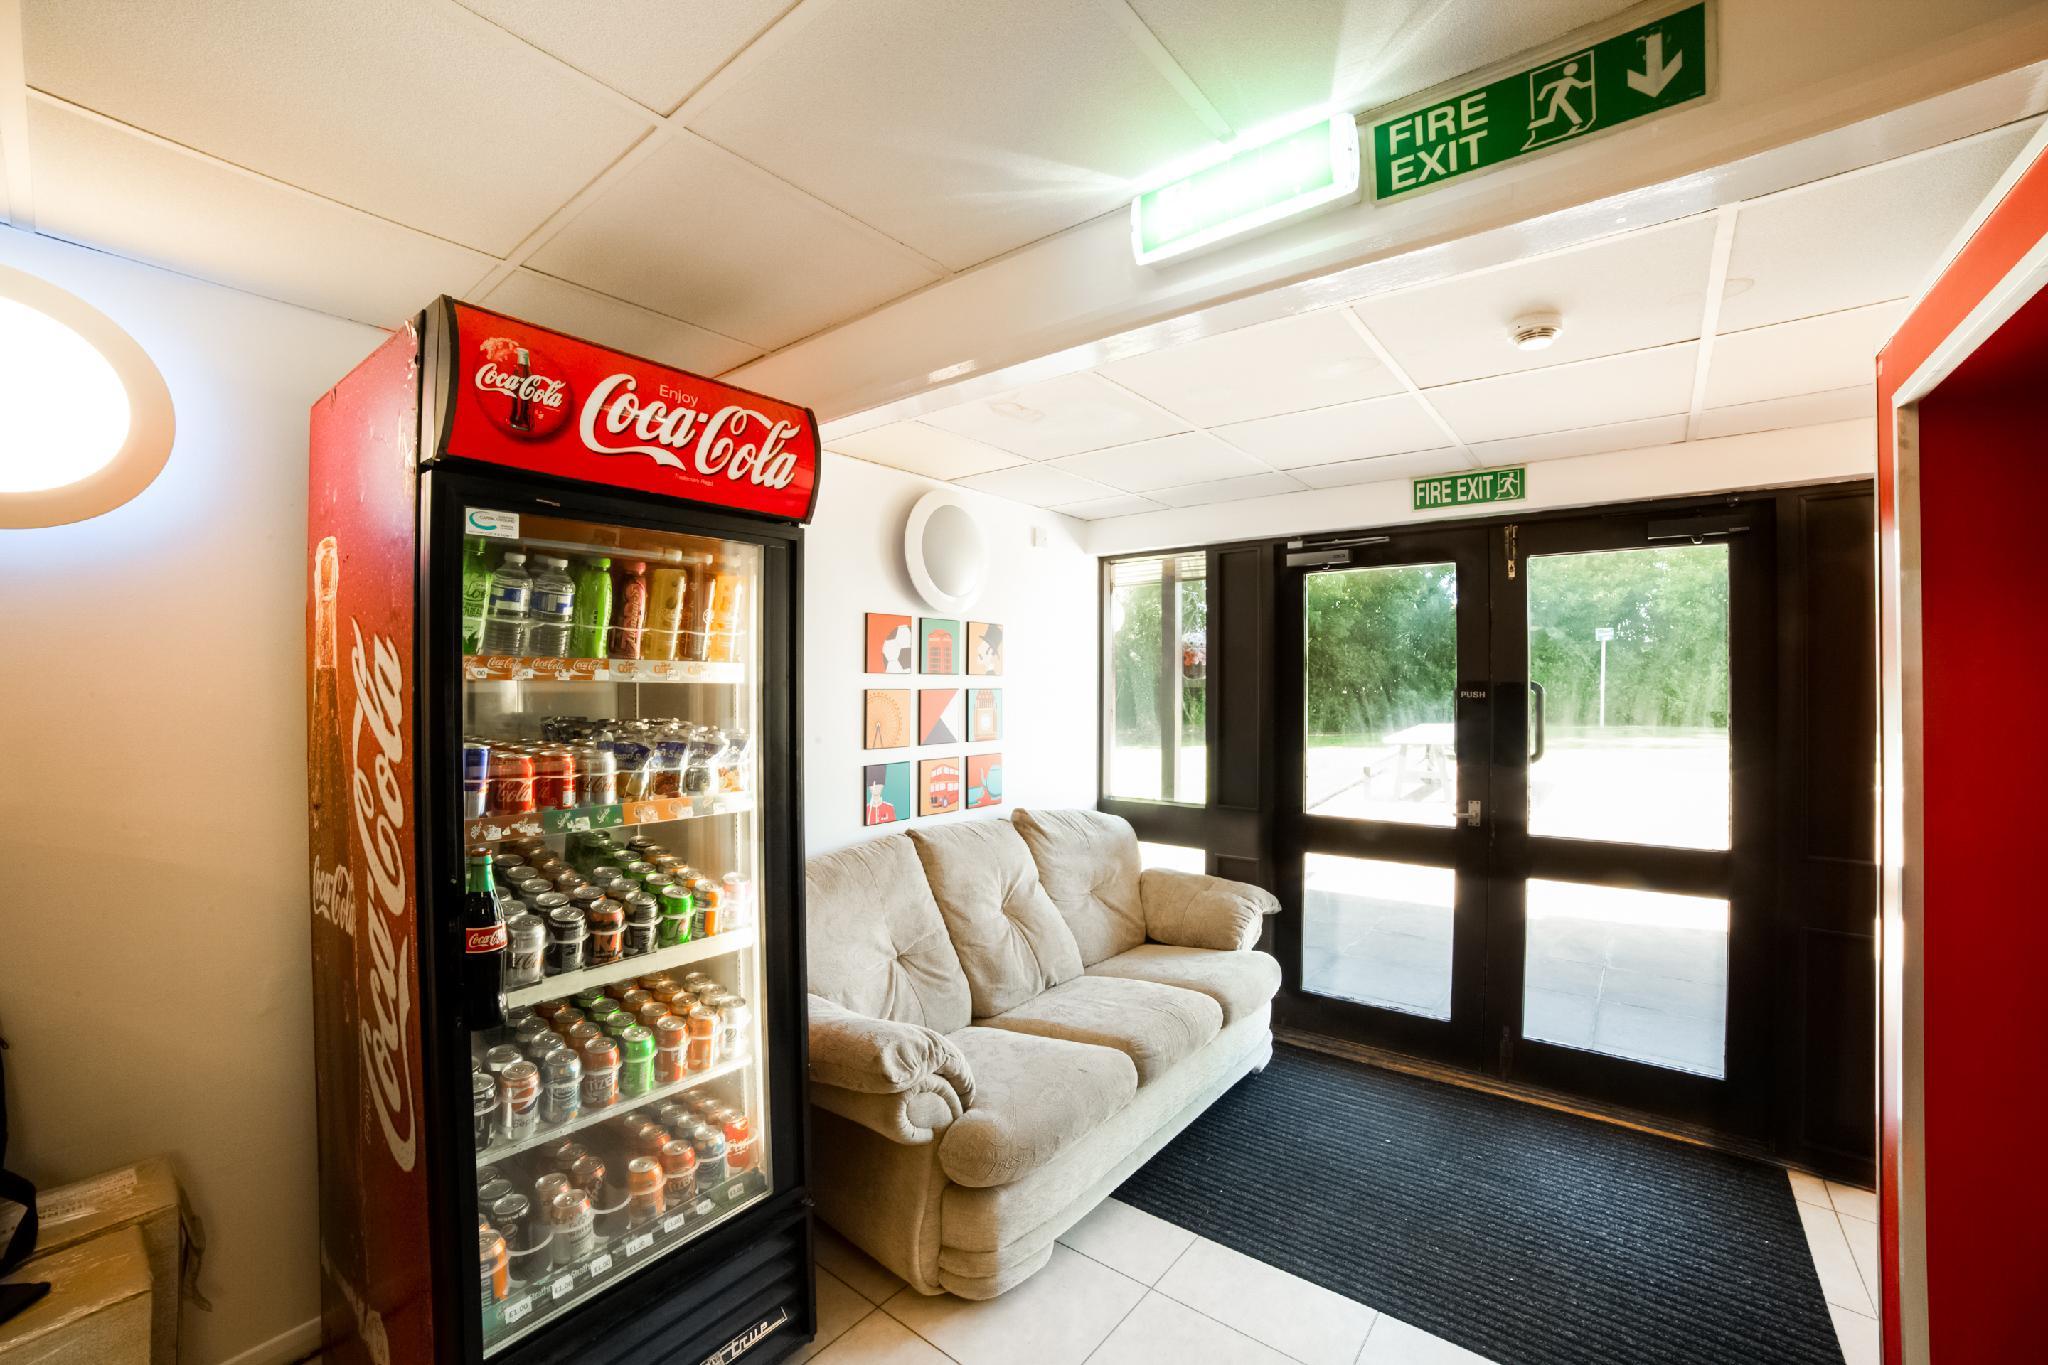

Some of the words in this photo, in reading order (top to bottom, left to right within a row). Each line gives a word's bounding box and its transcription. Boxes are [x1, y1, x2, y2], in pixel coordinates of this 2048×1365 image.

[1389, 92, 1489, 155] FIRE
[1391, 130, 1488, 191] EXIT
[475, 362, 566, 409] Coca-Cola
[659, 384, 699, 406] Enjoy
[579, 373, 801, 490] Coca-Cola
[1416, 480, 1452, 506] FIRE
[1457, 475, 1494, 502] EXIT
[313, 854, 356, 937] Coca-Cola
[350, 616, 416, 1173] Coca-Cola
